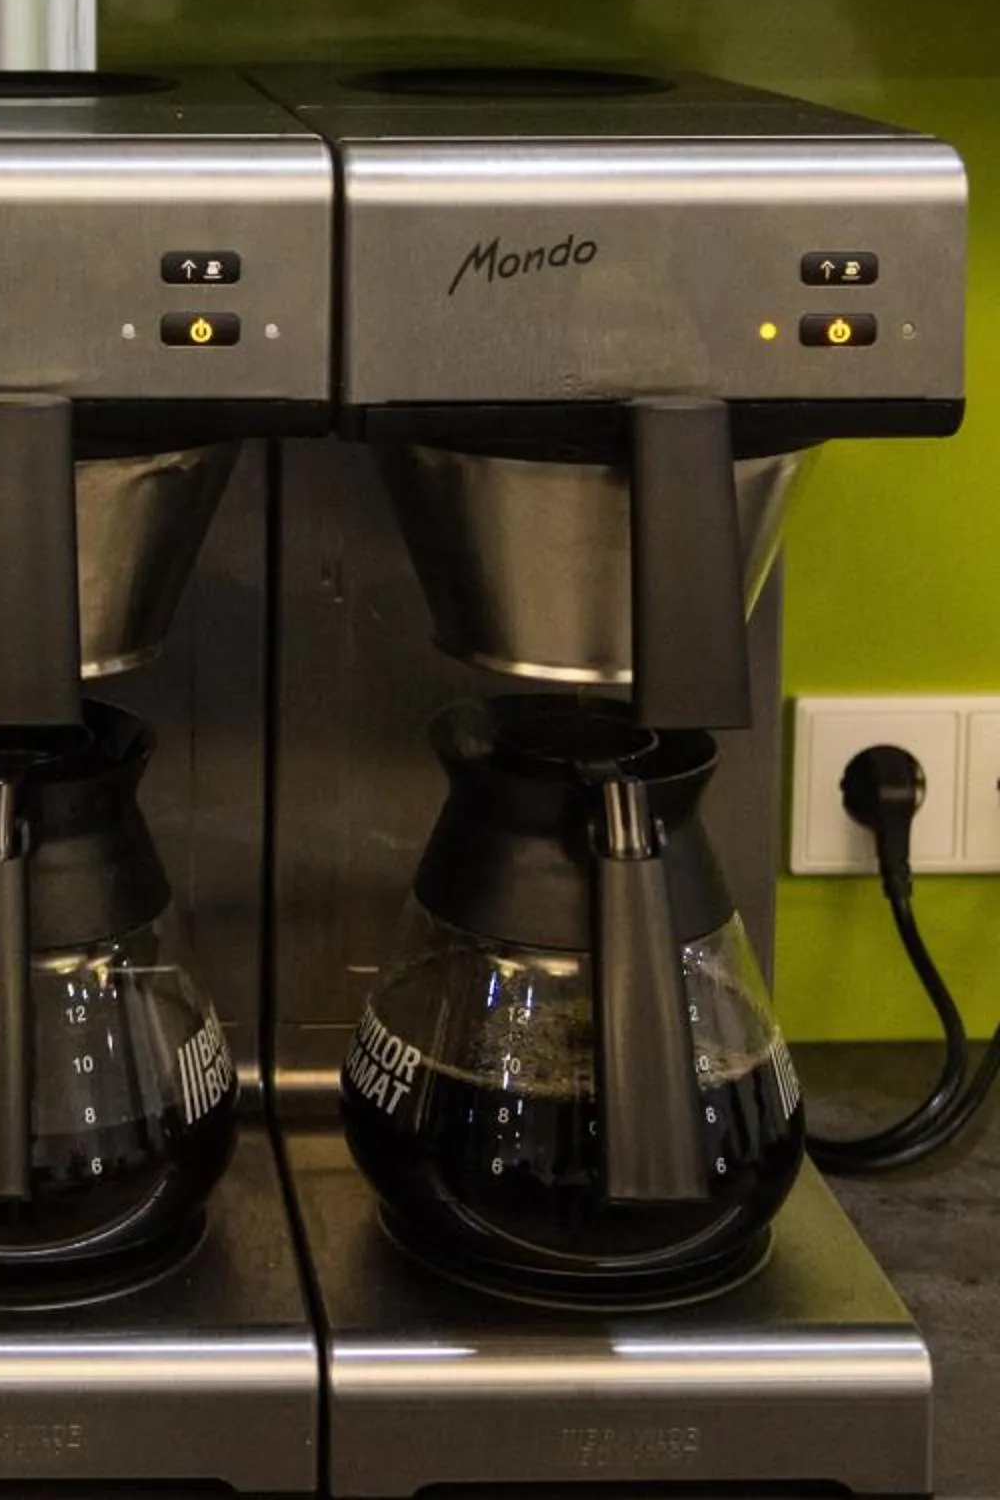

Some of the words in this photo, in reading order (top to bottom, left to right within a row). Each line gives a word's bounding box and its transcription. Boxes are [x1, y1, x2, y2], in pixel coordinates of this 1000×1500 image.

[448, 235, 598, 296] Mondo
[66, 1005, 87, 1024] 12
[507, 1007, 528, 1024] 12
[689, 1006, 699, 1021] 2
[73, 1055, 93, 1074] 10
[502, 1055, 521, 1075] 10
[85, 1107, 96, 1124] 8
[498, 1107, 509, 1123] 8
[705, 1106, 716, 1124] 8
[91, 1158, 102, 1175] 6
[492, 1158, 503, 1174] 6
[716, 1157, 726, 1174] 6
